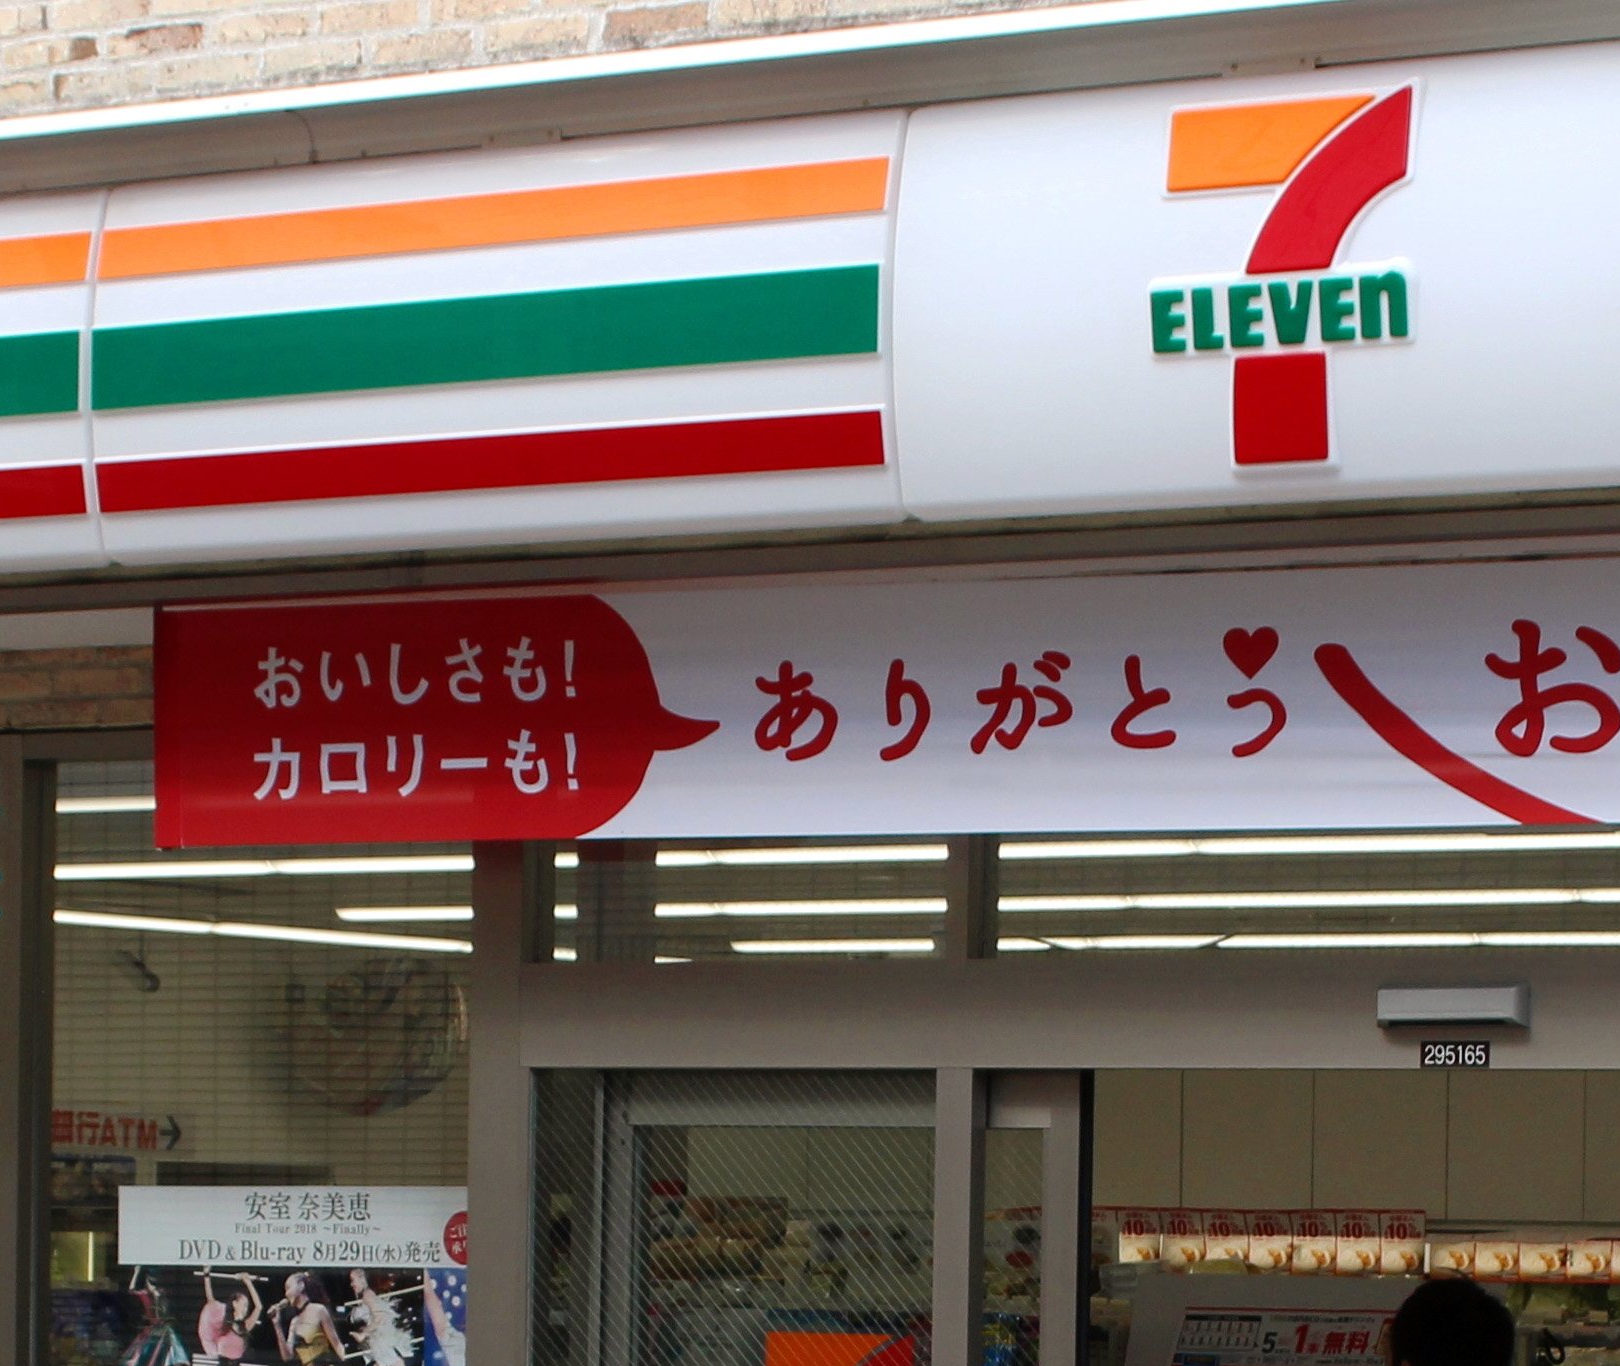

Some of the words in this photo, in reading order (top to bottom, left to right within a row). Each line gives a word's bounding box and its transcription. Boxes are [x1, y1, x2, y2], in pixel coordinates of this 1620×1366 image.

[1166, 85, 1412, 464] 7
[253, 637, 578, 708] おいしさも!
[753, 656, 1287, 762] ありがとう
[253, 732, 579, 800] カロリーも!
[1424, 1045, 1486, 1065] 295165
[243, 1190, 292, 1222] 安室
[297, 1190, 372, 1222] 奈美恵
[234, 1223, 263, 1235] Final
[265, 1223, 291, 1235] Tour
[293, 1224, 317, 1235] 2018
[177, 1238, 222, 1261] DVD
[224, 1248, 237, 1261] &
[239, 1238, 305, 1265] Blu-ray
[312, 1238, 441, 1264] 8月29日(水)発売
[1323, 1329, 1372, 1356] 無料
